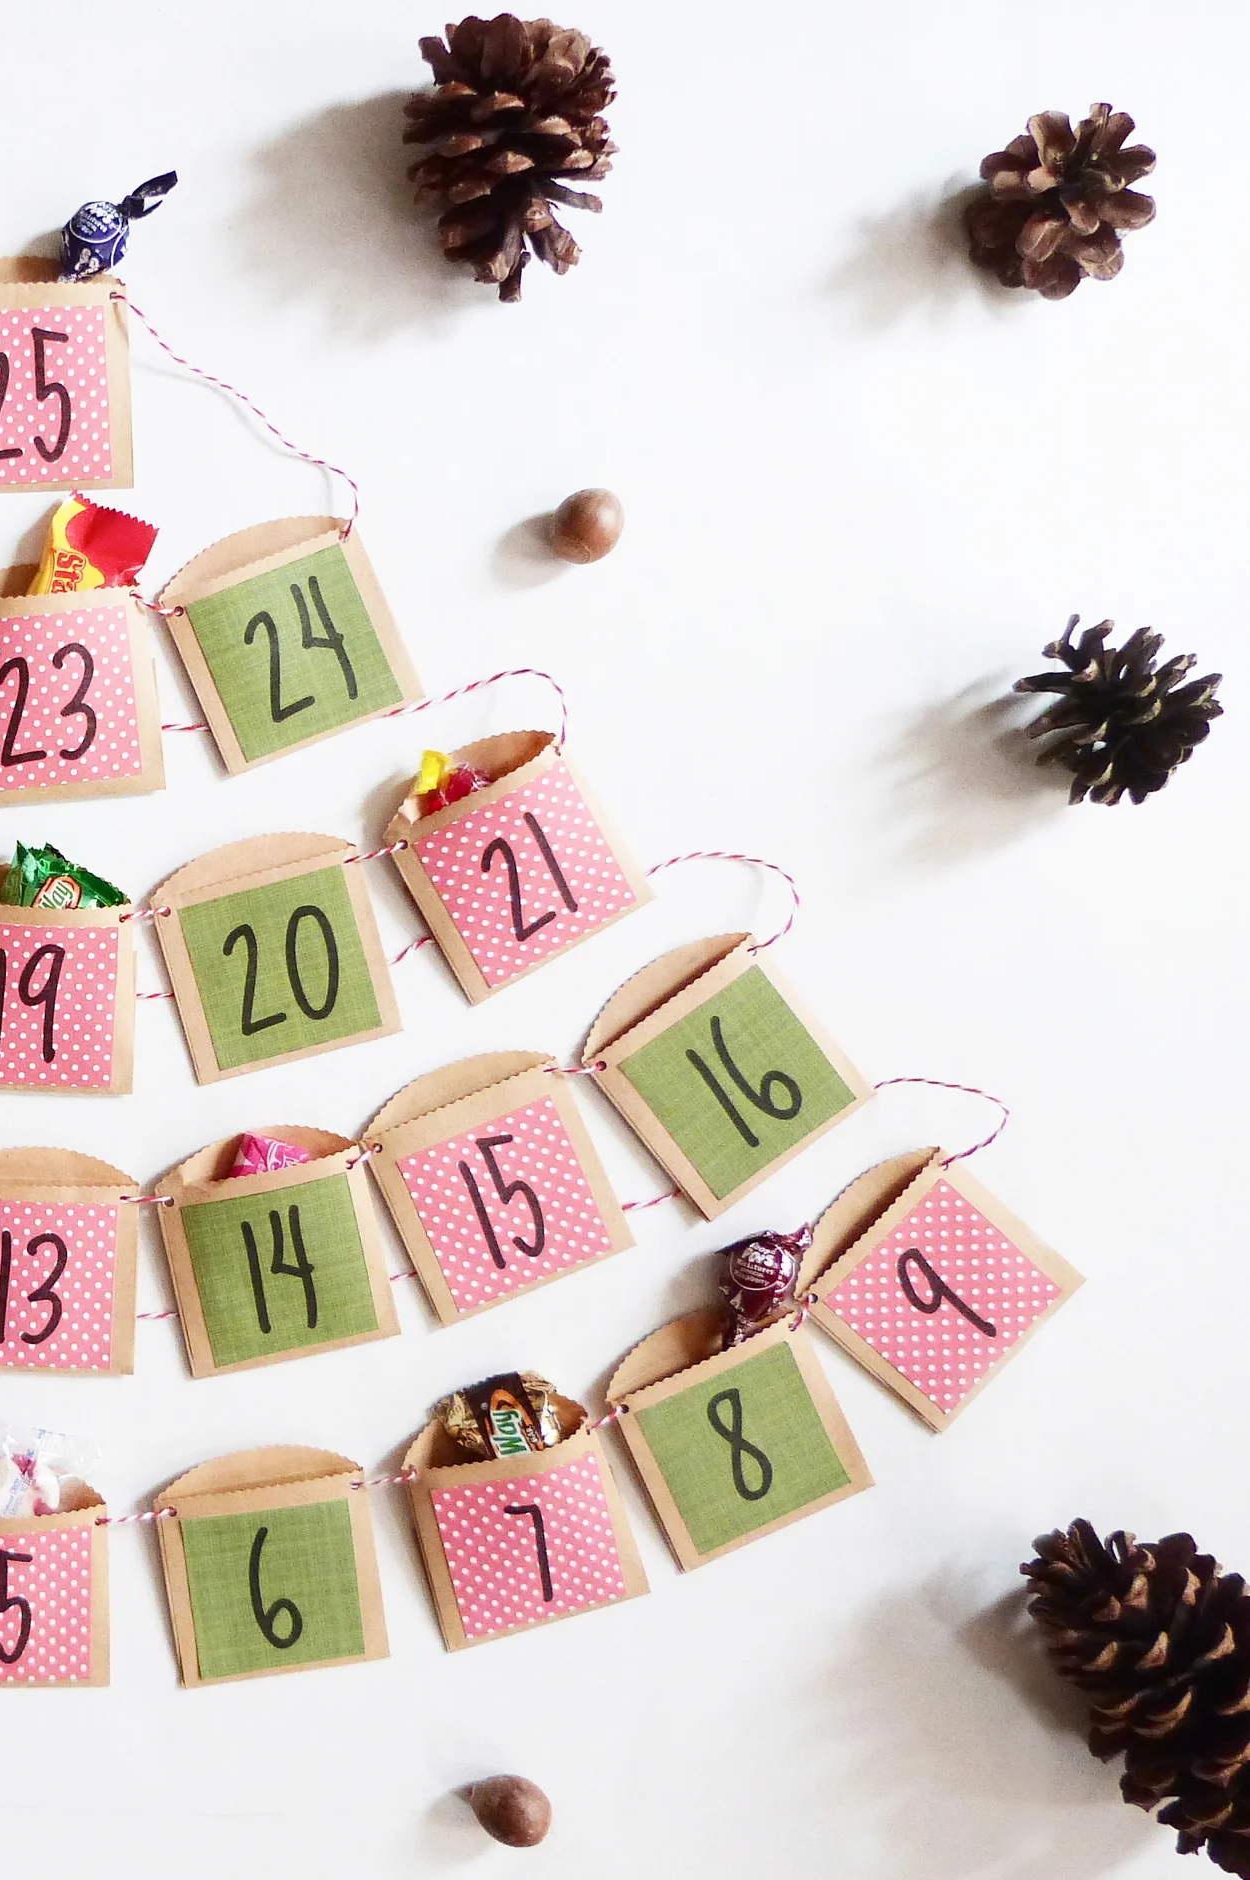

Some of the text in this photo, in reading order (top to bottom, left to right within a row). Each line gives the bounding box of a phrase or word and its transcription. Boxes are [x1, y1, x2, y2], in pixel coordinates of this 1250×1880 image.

[243, 575, 358, 724] 24
[480, 812, 579, 942] 21
[222, 904, 340, 1037] 20
[685, 1015, 803, 1148] 16
[457, 1134, 545, 1270] 15
[240, 1204, 318, 1334] 14
[896, 1247, 997, 1338] 9
[492, 1410, 528, 1456] Way
[706, 1387, 773, 1502] 8
[248, 1526, 304, 1650] 6
[503, 1503, 554, 1603] 7
